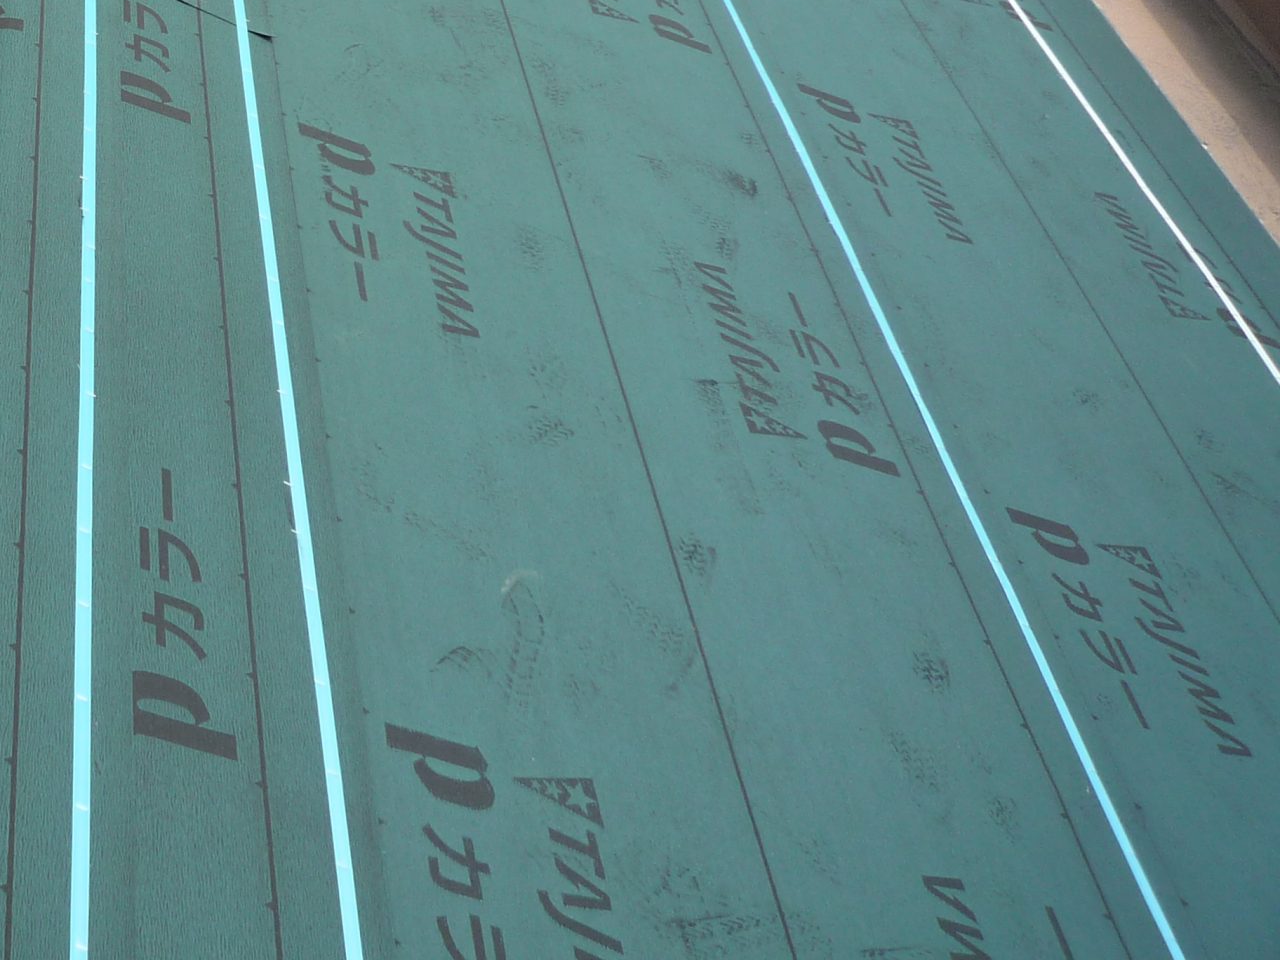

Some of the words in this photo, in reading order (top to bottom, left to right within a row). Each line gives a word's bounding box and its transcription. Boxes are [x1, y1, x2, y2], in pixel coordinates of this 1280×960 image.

[892, 135, 974, 244] TAJIMA
[403, 191, 480, 338] TAJIMA
[694, 261, 781, 405] TAJIMA
[1129, 578, 1252, 758] TAJIMA
